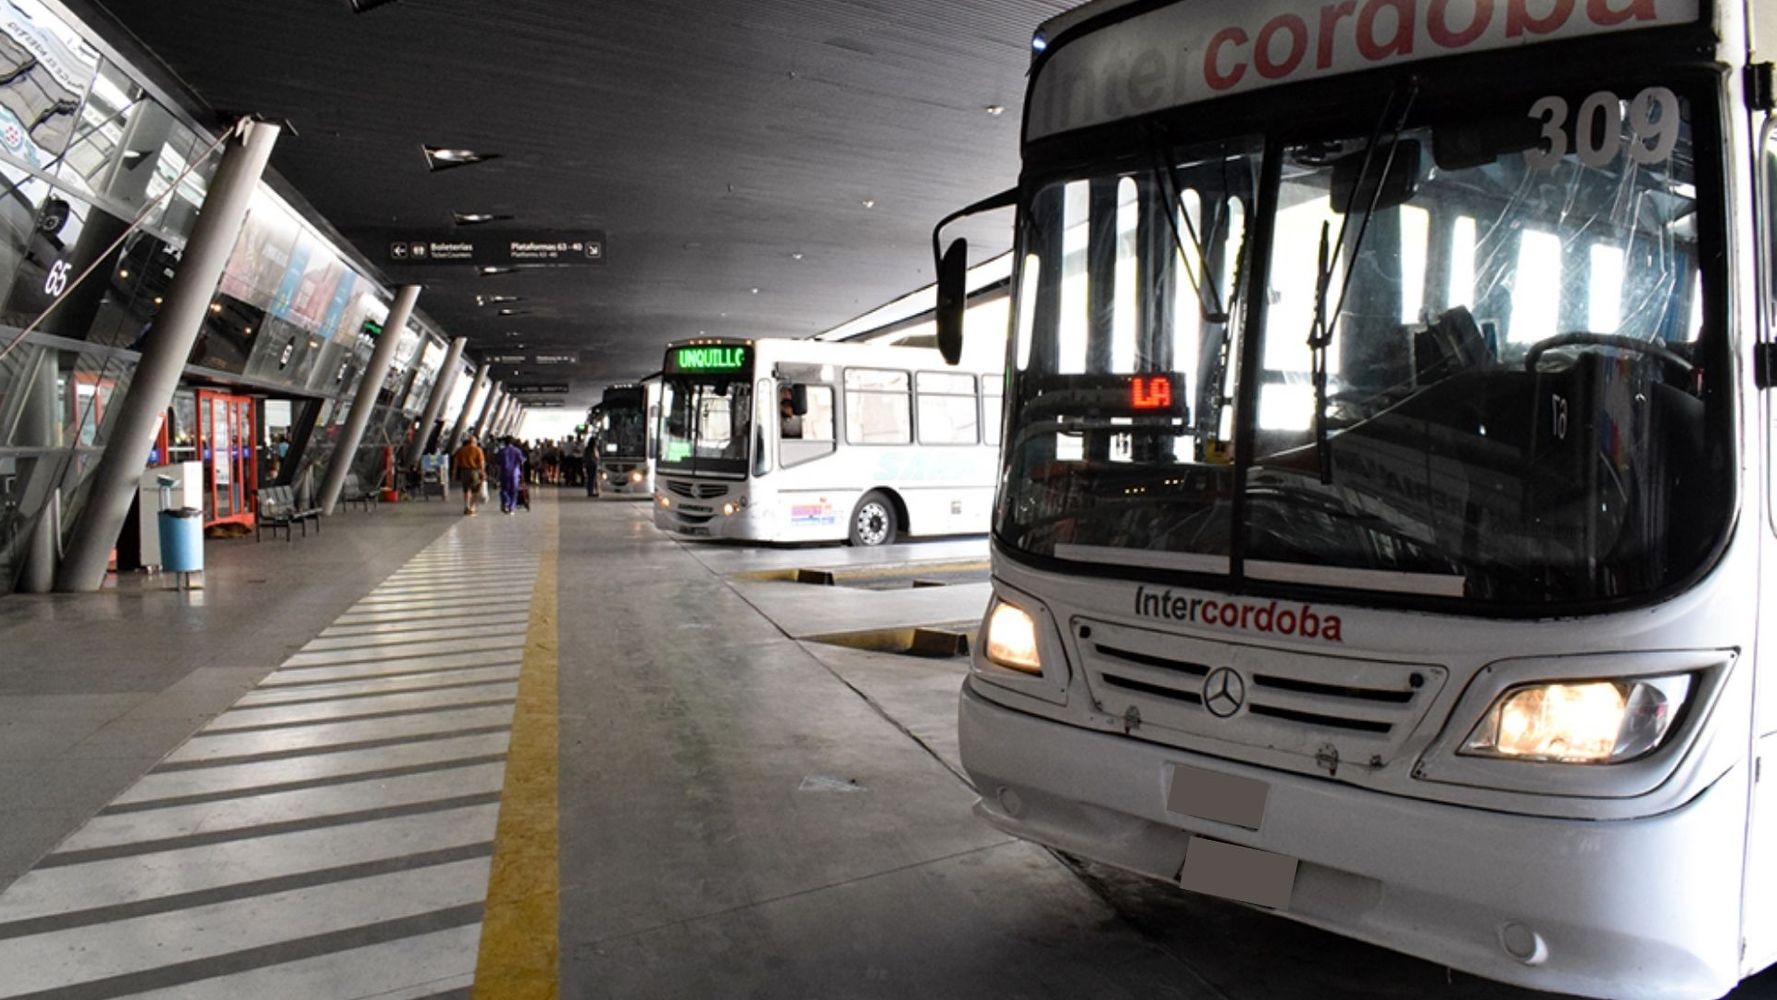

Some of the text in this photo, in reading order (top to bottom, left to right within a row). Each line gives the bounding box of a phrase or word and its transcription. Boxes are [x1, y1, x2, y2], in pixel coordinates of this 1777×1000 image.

[1526, 85, 1681, 170] 309
[510, 241, 556, 251] Plataformas
[45, 259, 73, 297] 65
[1132, 377, 1171, 408] LA
[1134, 584, 1344, 643] Intercordoba
